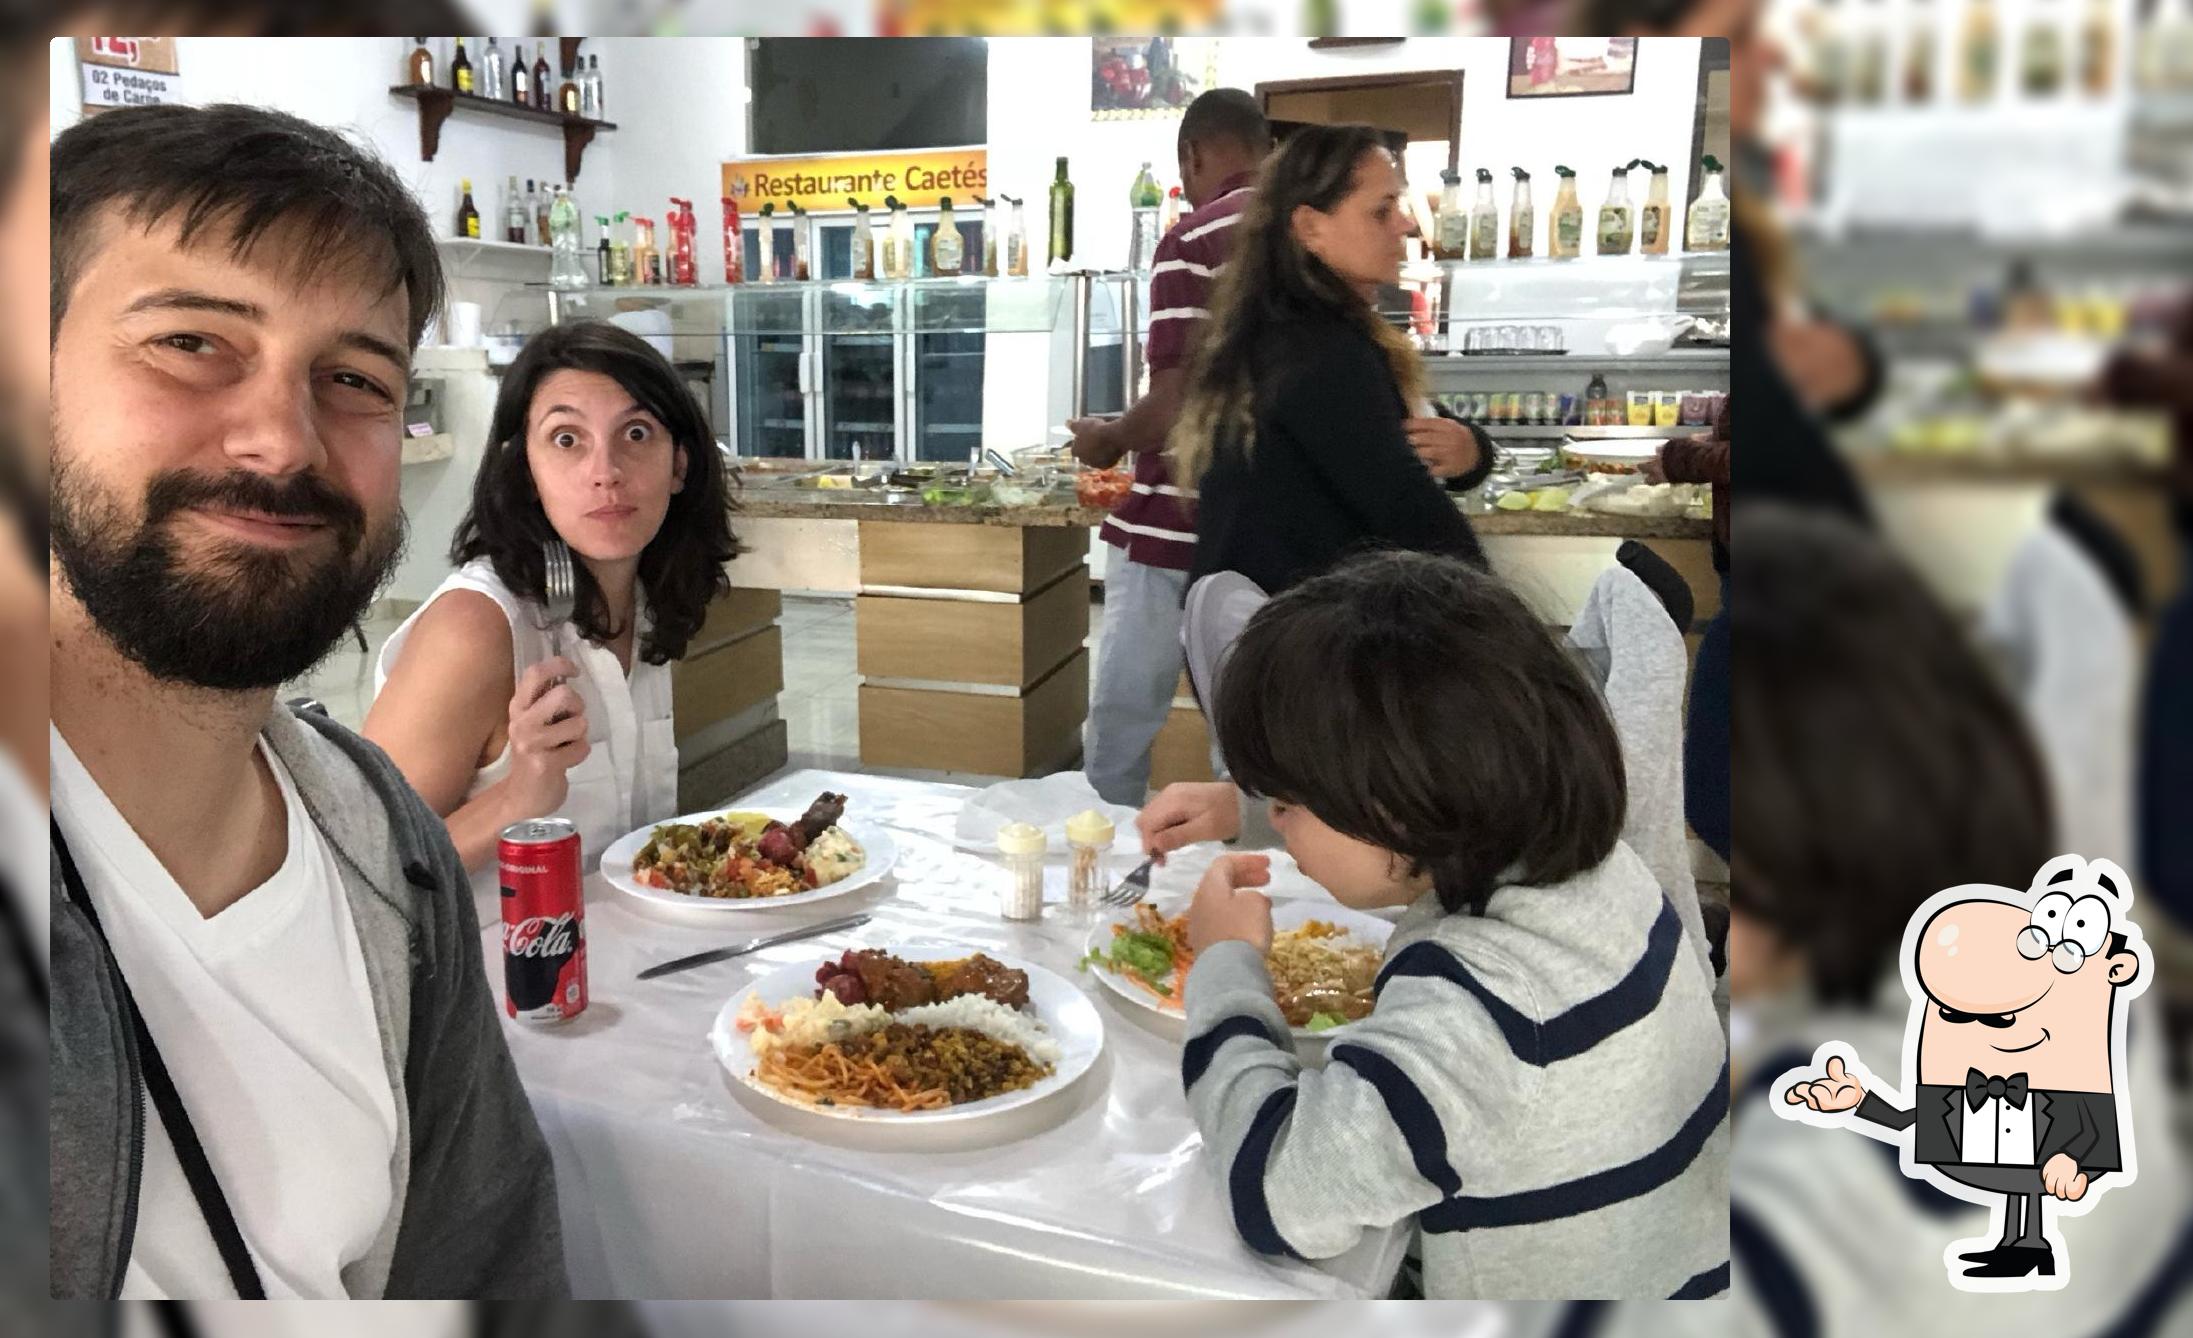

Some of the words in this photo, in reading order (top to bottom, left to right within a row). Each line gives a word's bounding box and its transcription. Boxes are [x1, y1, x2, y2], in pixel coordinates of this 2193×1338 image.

[92, 69, 109, 84] 02
[113, 72, 167, 93] Pedaços
[103, 88, 119, 101] de
[123, 89, 161, 104] Carne
[754, 169, 896, 198] Restaurante
[904, 161, 987, 191] Caetés
